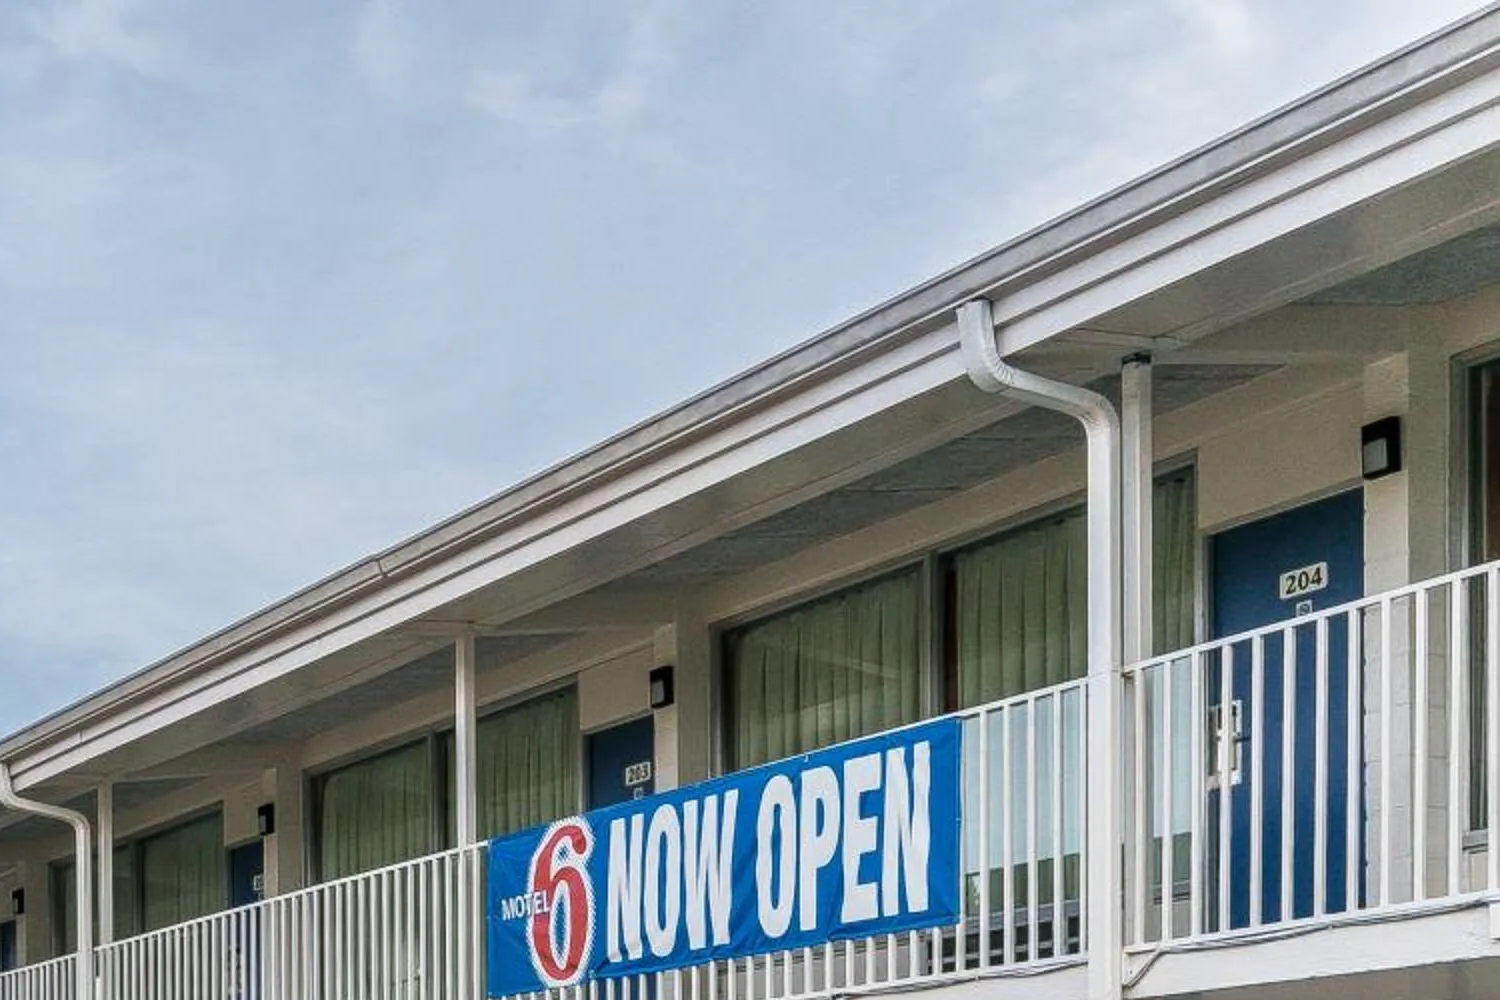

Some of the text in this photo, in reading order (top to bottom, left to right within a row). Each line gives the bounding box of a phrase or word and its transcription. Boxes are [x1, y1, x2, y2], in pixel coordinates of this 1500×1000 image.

[1285, 567, 1323, 594] 204
[501, 816, 596, 987] MOTEL 6
[607, 741, 931, 963] NOW OPEN
